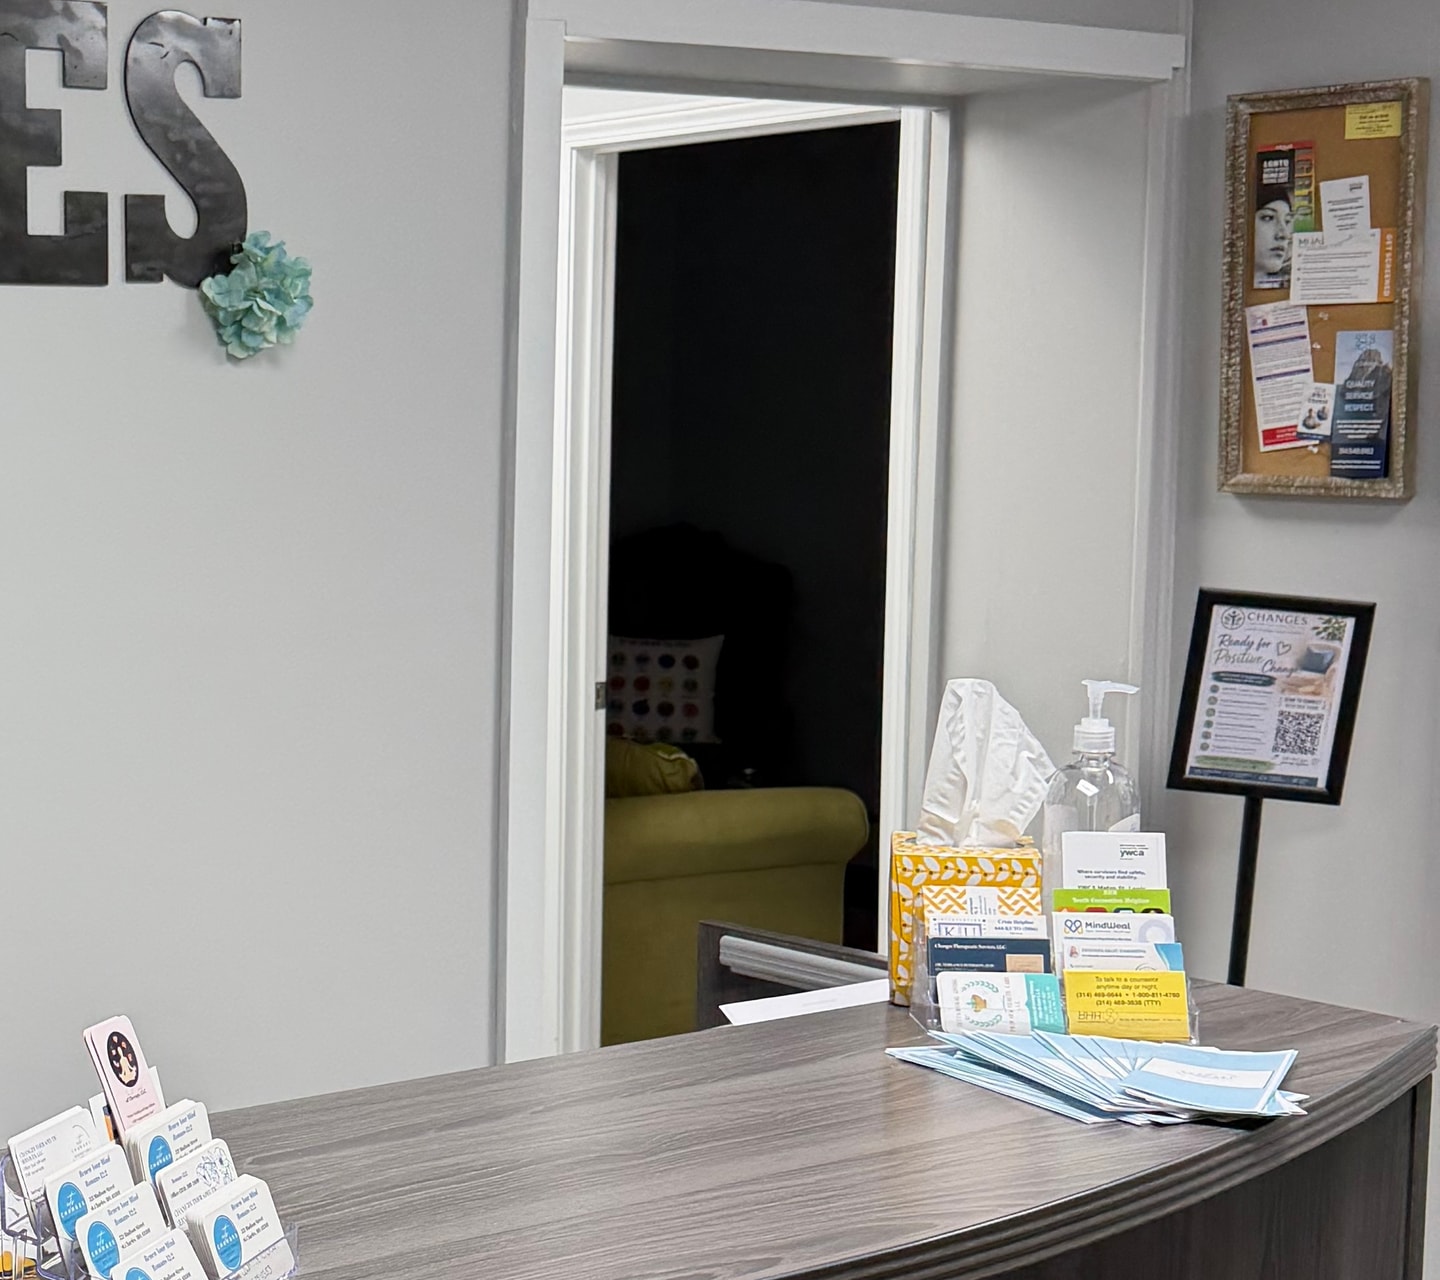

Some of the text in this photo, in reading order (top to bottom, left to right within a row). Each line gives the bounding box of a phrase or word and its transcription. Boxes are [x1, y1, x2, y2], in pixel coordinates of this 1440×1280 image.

[1346, 380, 1375, 389] QUALITY
[1247, 611, 1308, 626] CHANGES
[1217, 634, 1271, 651] Ready for
[1213, 648, 1264, 664] Positive
[1120, 849, 1145, 858] ywca
[1085, 921, 1131, 930] MindWeal
